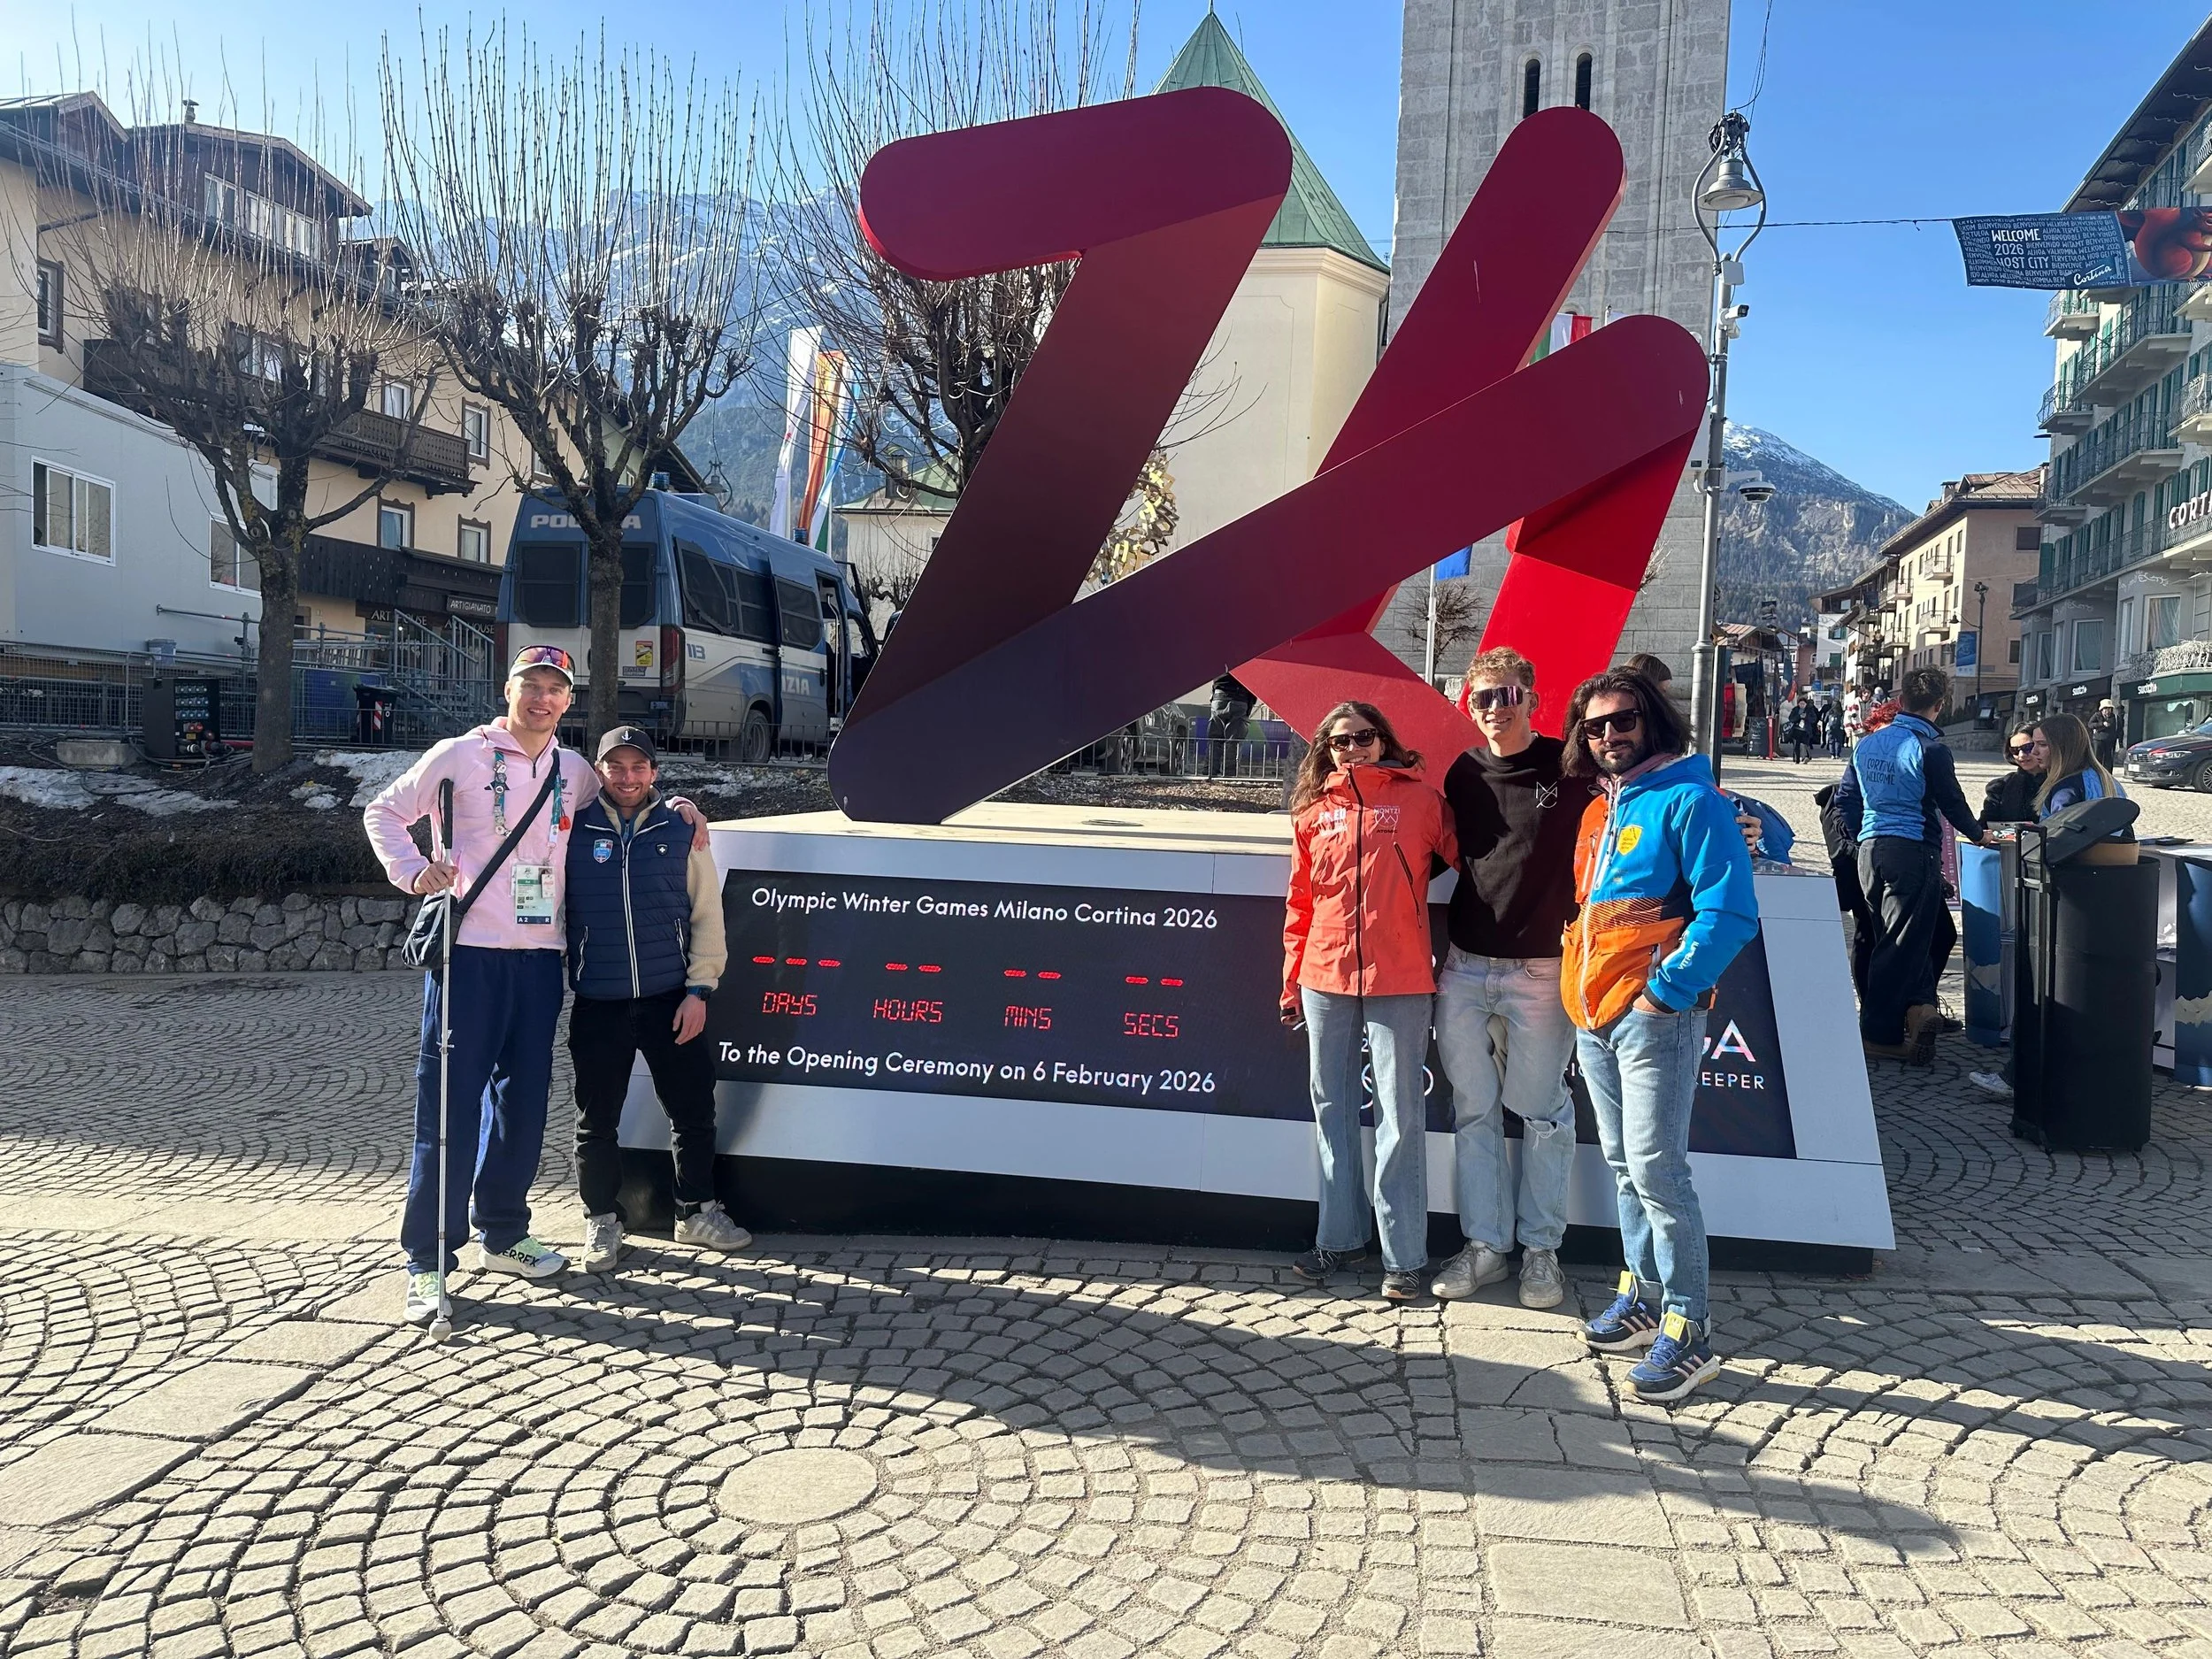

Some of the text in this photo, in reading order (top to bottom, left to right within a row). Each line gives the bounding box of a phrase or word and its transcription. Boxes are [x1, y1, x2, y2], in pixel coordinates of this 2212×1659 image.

[1991, 228, 2040, 242] WELCOME
[1994, 243, 2024, 256] 2026
[1996, 257, 2024, 269] HOST
[531, 515, 641, 529] POLA
[686, 643, 706, 661] 113
[752, 888, 1217, 929] Olympic Winter Games Milano Cortina 2026
[762, 991, 1179, 1038] DAYS HOURS MINS SECS
[718, 1041, 1216, 1095] To the Opening Ceremony on 6 February 2026
[1701, 1071, 1764, 1090] EEPER
